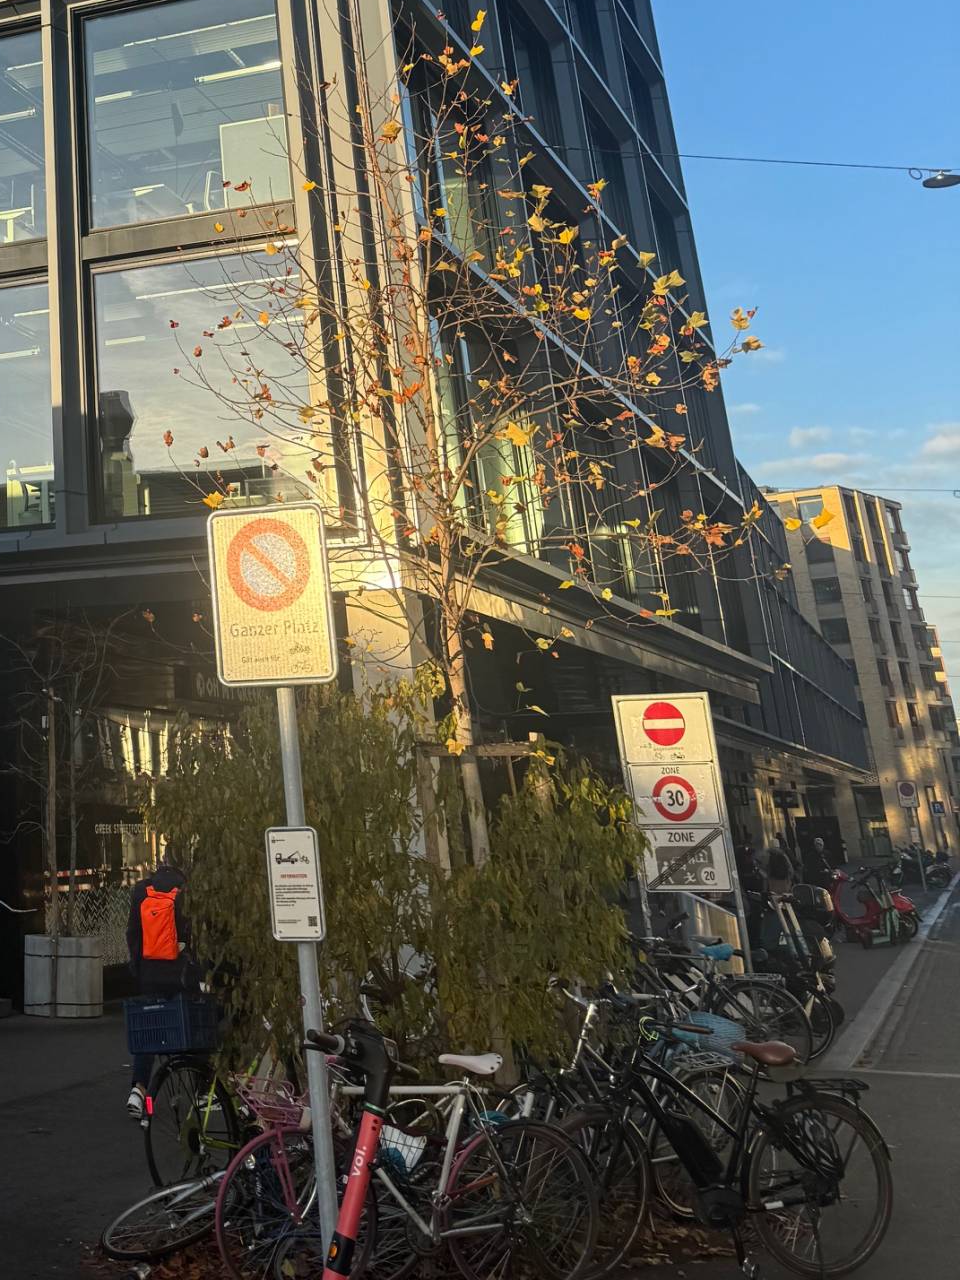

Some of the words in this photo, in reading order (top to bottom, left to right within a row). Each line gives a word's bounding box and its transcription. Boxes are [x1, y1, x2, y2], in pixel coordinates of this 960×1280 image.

[231, 623, 278, 637] Ganzer
[661, 767, 681, 775] ZONE
[666, 790, 684, 807] 30
[667, 832, 695, 843] ZONE
[703, 870, 715, 882] 20
[352, 1146, 367, 1176] voi.
